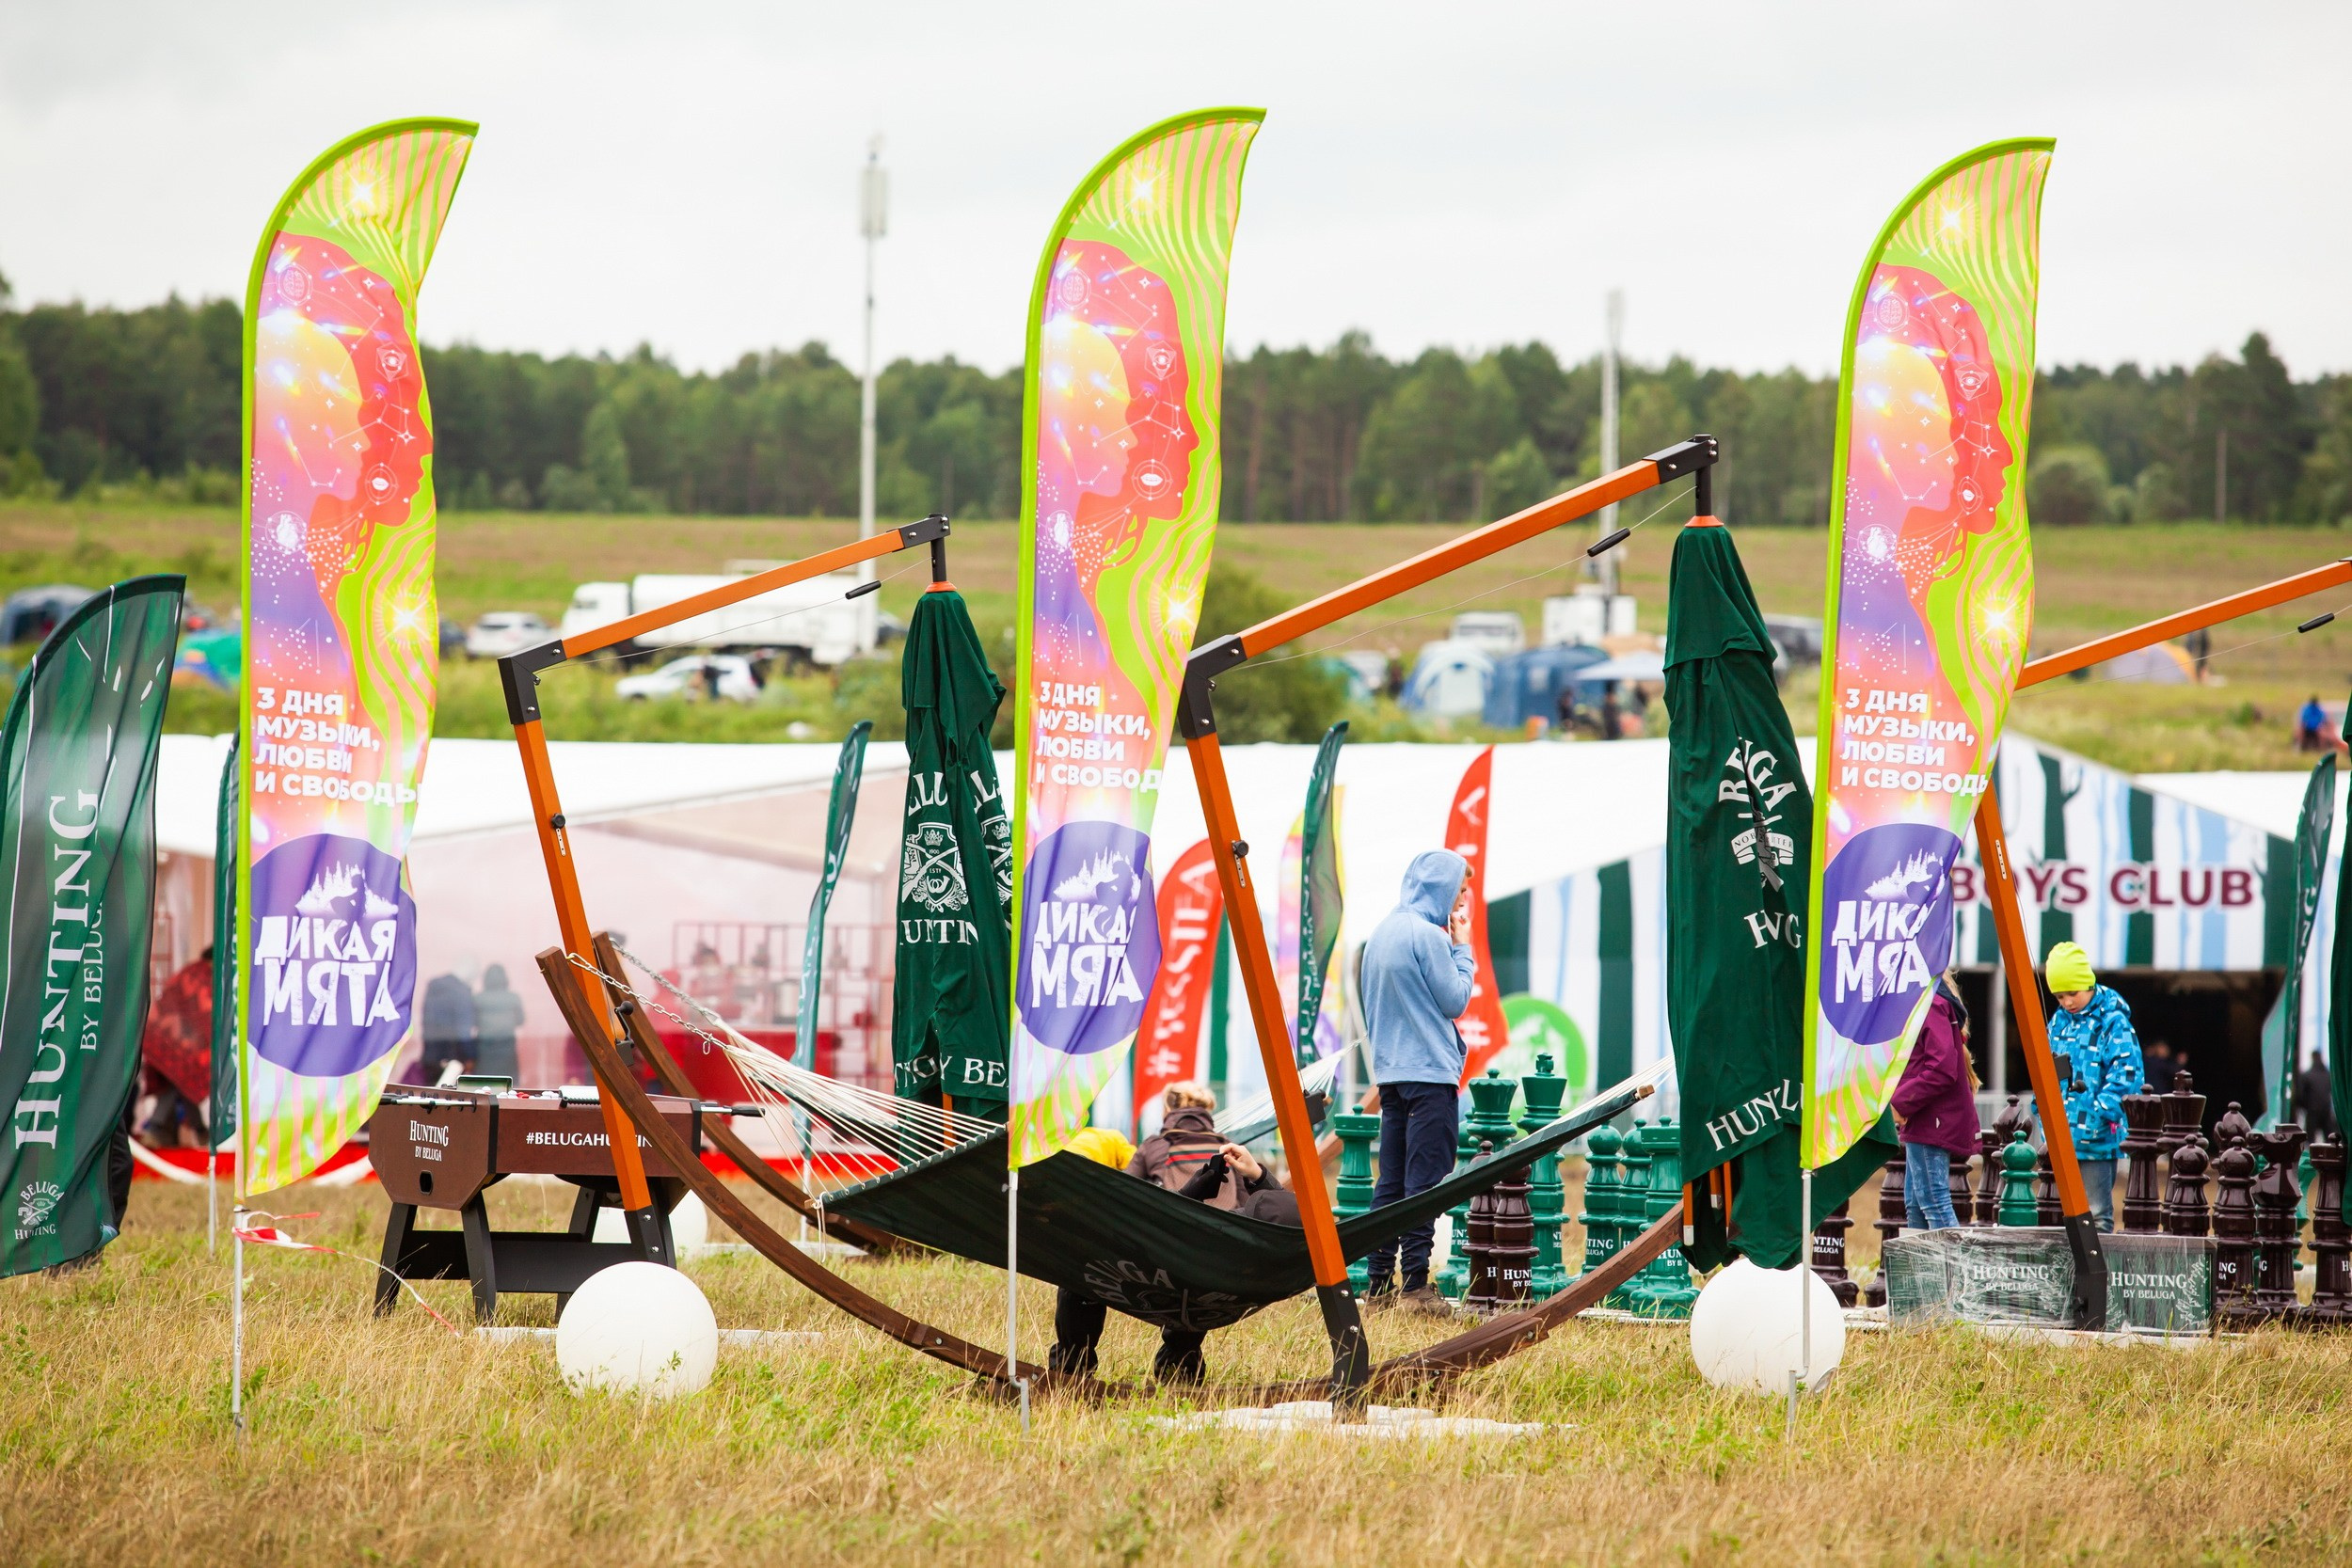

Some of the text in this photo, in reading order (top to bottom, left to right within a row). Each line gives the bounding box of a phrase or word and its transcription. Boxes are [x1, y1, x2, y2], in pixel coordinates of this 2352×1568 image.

[257, 687, 343, 717] 3 ДНЯ
[1052, 683, 1101, 708] ДНЯ
[1845, 688, 1928, 715] 3 ДНЯ
[257, 715, 380, 752] МУЗЫКИ,
[1039, 708, 1152, 740] МУЗЫКИ,
[1844, 715, 1975, 746] МУЗЫКИ,
[255, 743, 353, 774] ЛЮБВИ
[1036, 736, 1124, 762] ЛЮБВИ
[1842, 740, 1946, 767] ЛЮБВИ
[255, 770, 276, 793] И
[1036, 762, 1045, 784] И
[1841, 767, 1859, 786] И
[1952, 866, 2253, 906] BYS CLUB
[254, 915, 397, 966] ДИКАЯ
[15, 788, 99, 1150] HUNTING
[1031, 942, 1145, 1009] МЯТА
[263, 957, 401, 1028] МЯТА
[80, 1014, 100, 1051] BY
[409, 1119, 450, 1148] HUNTING
[415, 1145, 442, 1162] BY BELUGA
[20, 1180, 65, 1201] BELUGA
[1973, 1264, 2049, 1280] HUNTING
[2110, 1271, 2187, 1290] HUNTING
[1985, 1282, 2039, 1292] BY BELUGA
[2122, 1289, 2176, 1300] BY BELUGA
